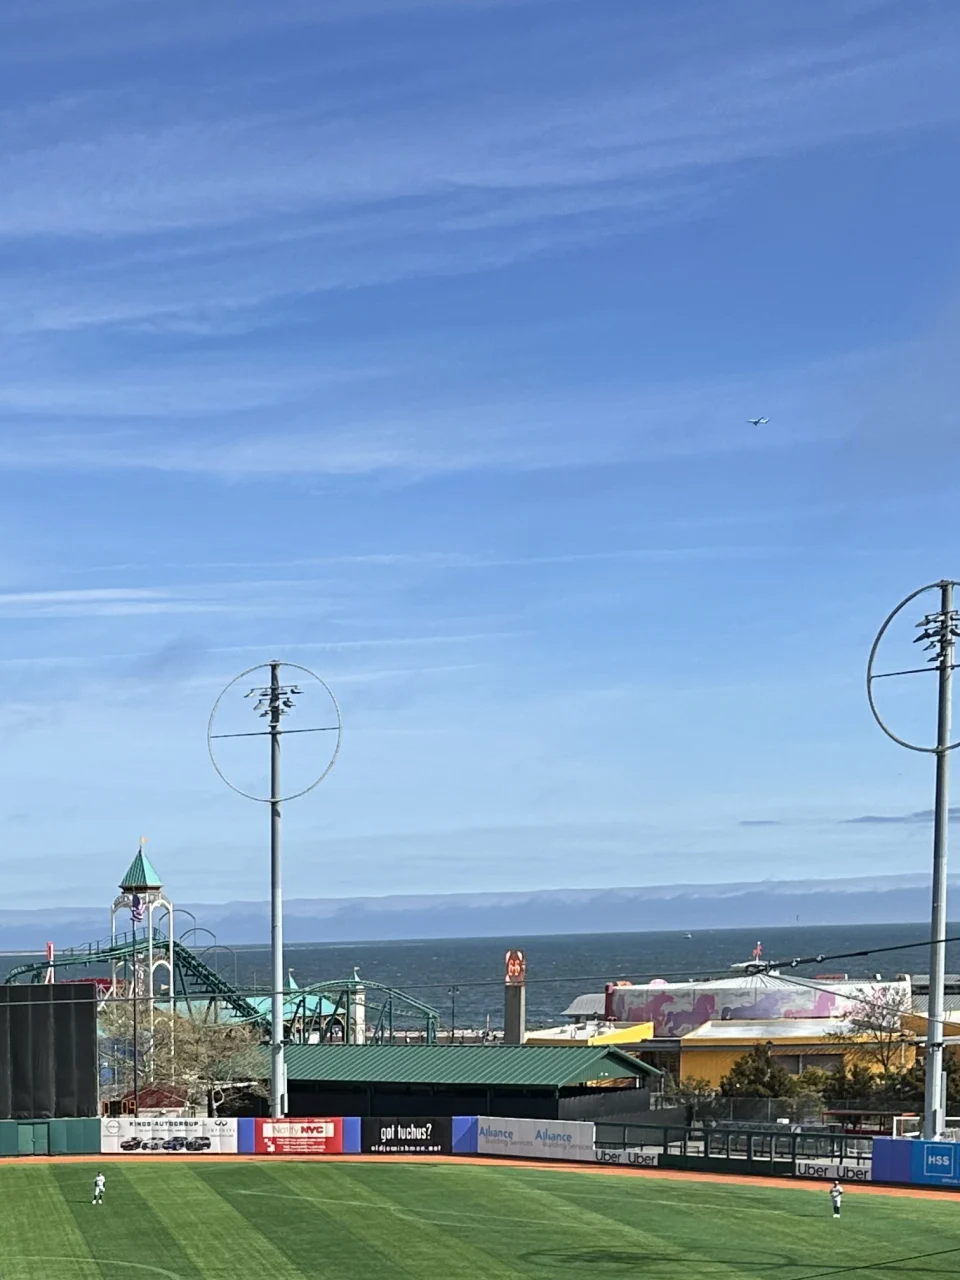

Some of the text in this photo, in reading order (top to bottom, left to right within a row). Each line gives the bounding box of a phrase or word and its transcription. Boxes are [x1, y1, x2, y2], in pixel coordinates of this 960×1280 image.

[272, 1125, 323, 1135] Notify NYC
[380, 1123, 432, 1142] got tuchus?
[479, 1125, 513, 1139] Alliance
[535, 1128, 572, 1142] Alliance
[595, 1151, 657, 1165] Uber Uber
[928, 1155, 950, 1166] HSS
[798, 1163, 869, 1180] Uber Uber
